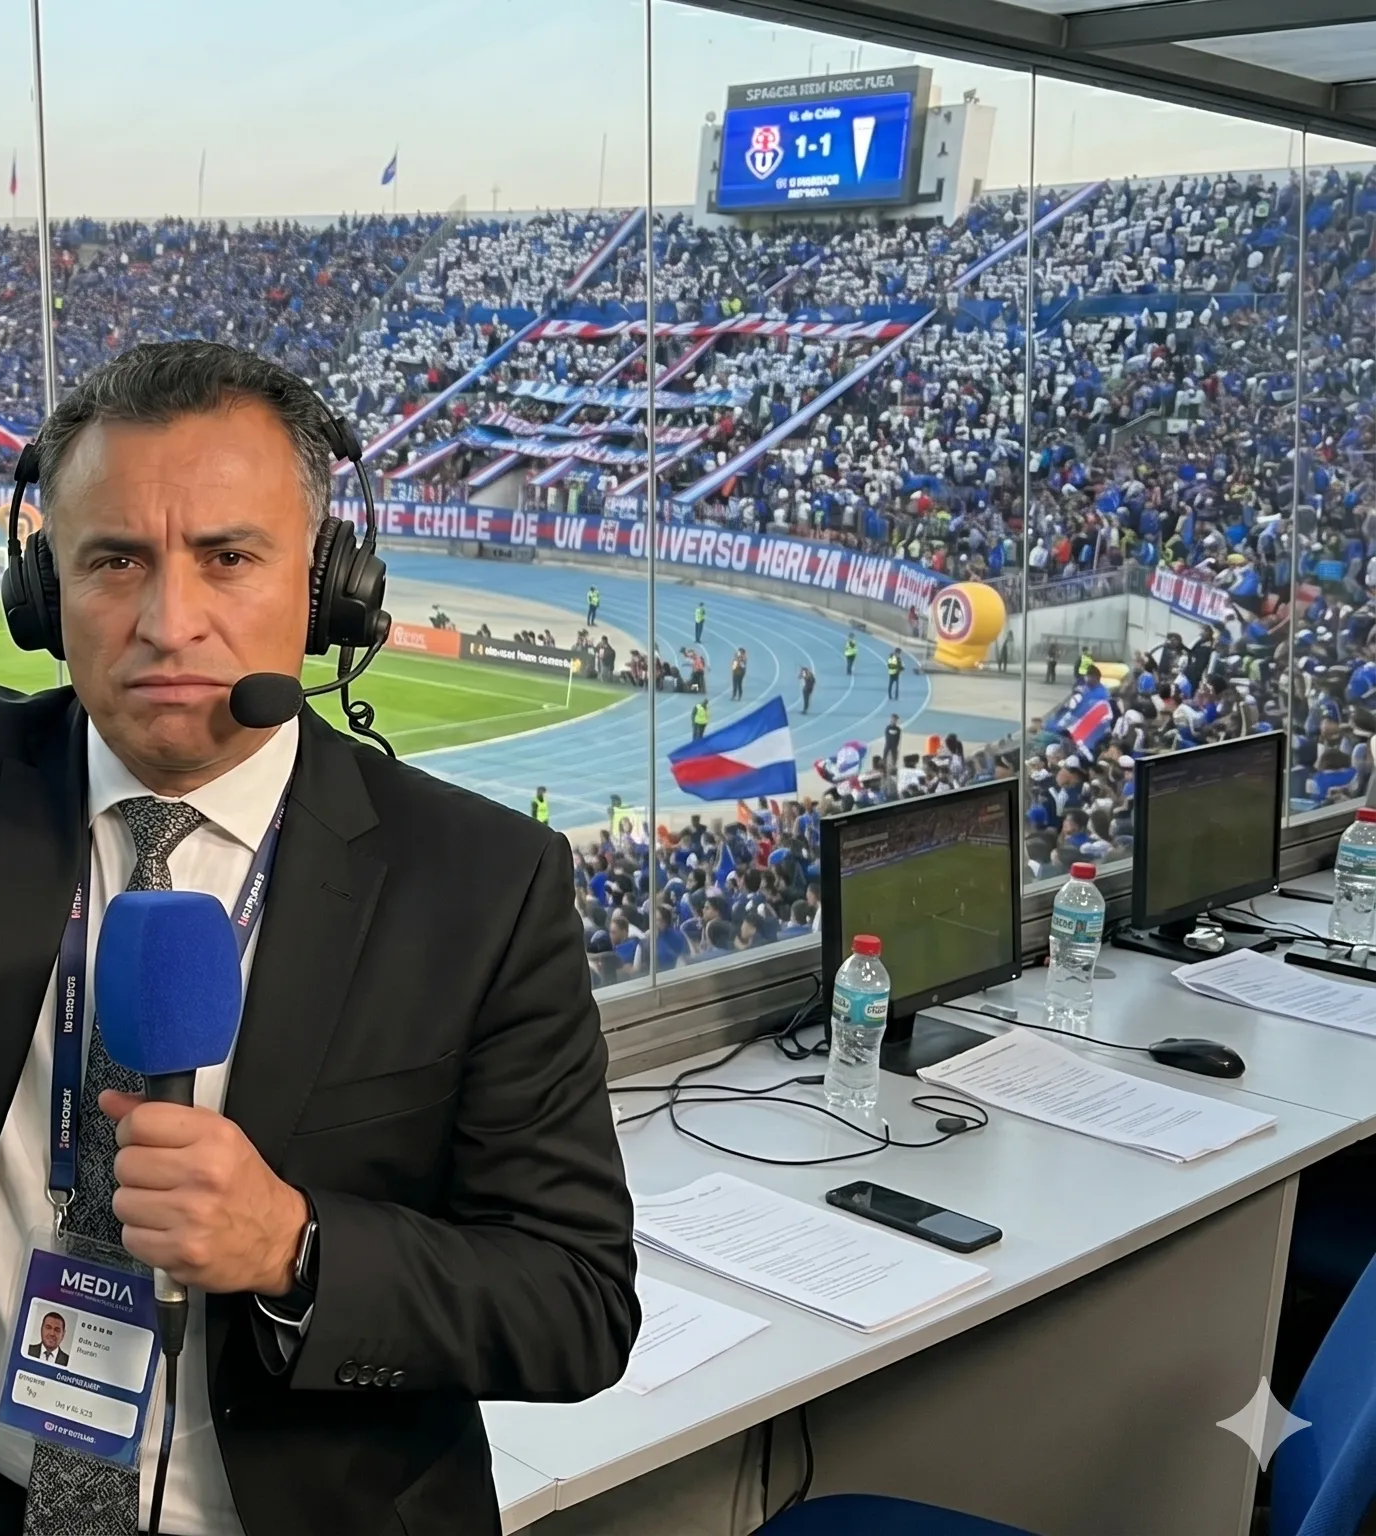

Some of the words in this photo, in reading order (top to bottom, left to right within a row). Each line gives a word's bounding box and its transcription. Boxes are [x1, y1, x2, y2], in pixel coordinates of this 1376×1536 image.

[795, 132, 832, 159] 1-1
[754, 152, 774, 173] U
[414, 505, 493, 541] CHILE
[510, 511, 539, 546] DE
[554, 516, 586, 549] UN
[60, 1268, 133, 1306] MEDIA
